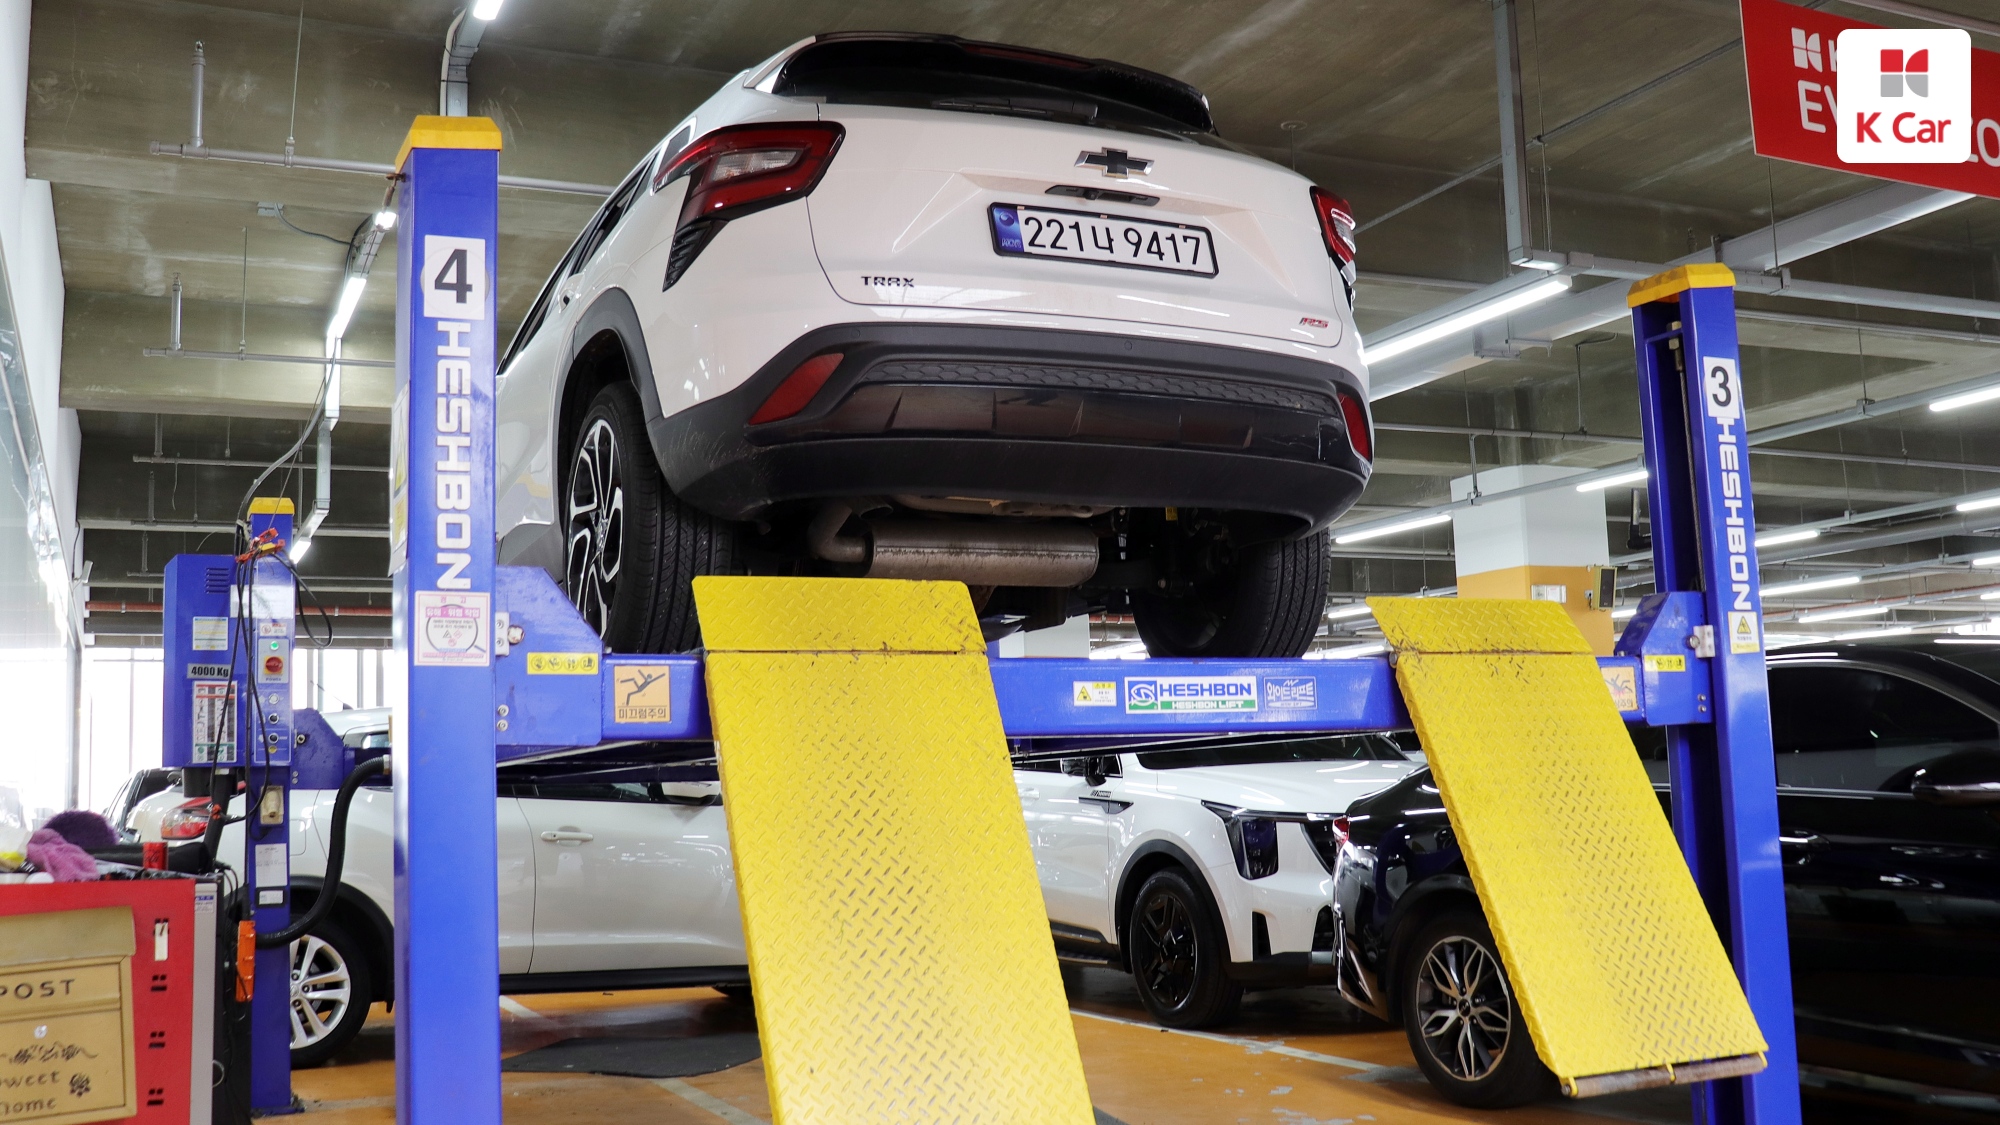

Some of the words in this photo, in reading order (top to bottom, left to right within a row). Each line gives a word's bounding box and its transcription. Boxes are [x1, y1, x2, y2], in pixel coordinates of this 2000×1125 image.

[1024, 217, 1114, 254] 221나
[1123, 228, 1200, 265] 9417
[434, 248, 473, 304] 4
[861, 276, 914, 287] TRAX
[1710, 366, 1732, 407] 3
[436, 320, 472, 590] HESHBON
[1716, 417, 1752, 611] HESHBON
[191, 666, 216, 676] 4000
[217, 667, 230, 678] Kg
[1159, 683, 1251, 697] HESHBON
[618, 708, 667, 719] 미끄럼주의
[1172, 701, 1217, 709] HESHBON
[1218, 700, 1244, 709] LIFT
